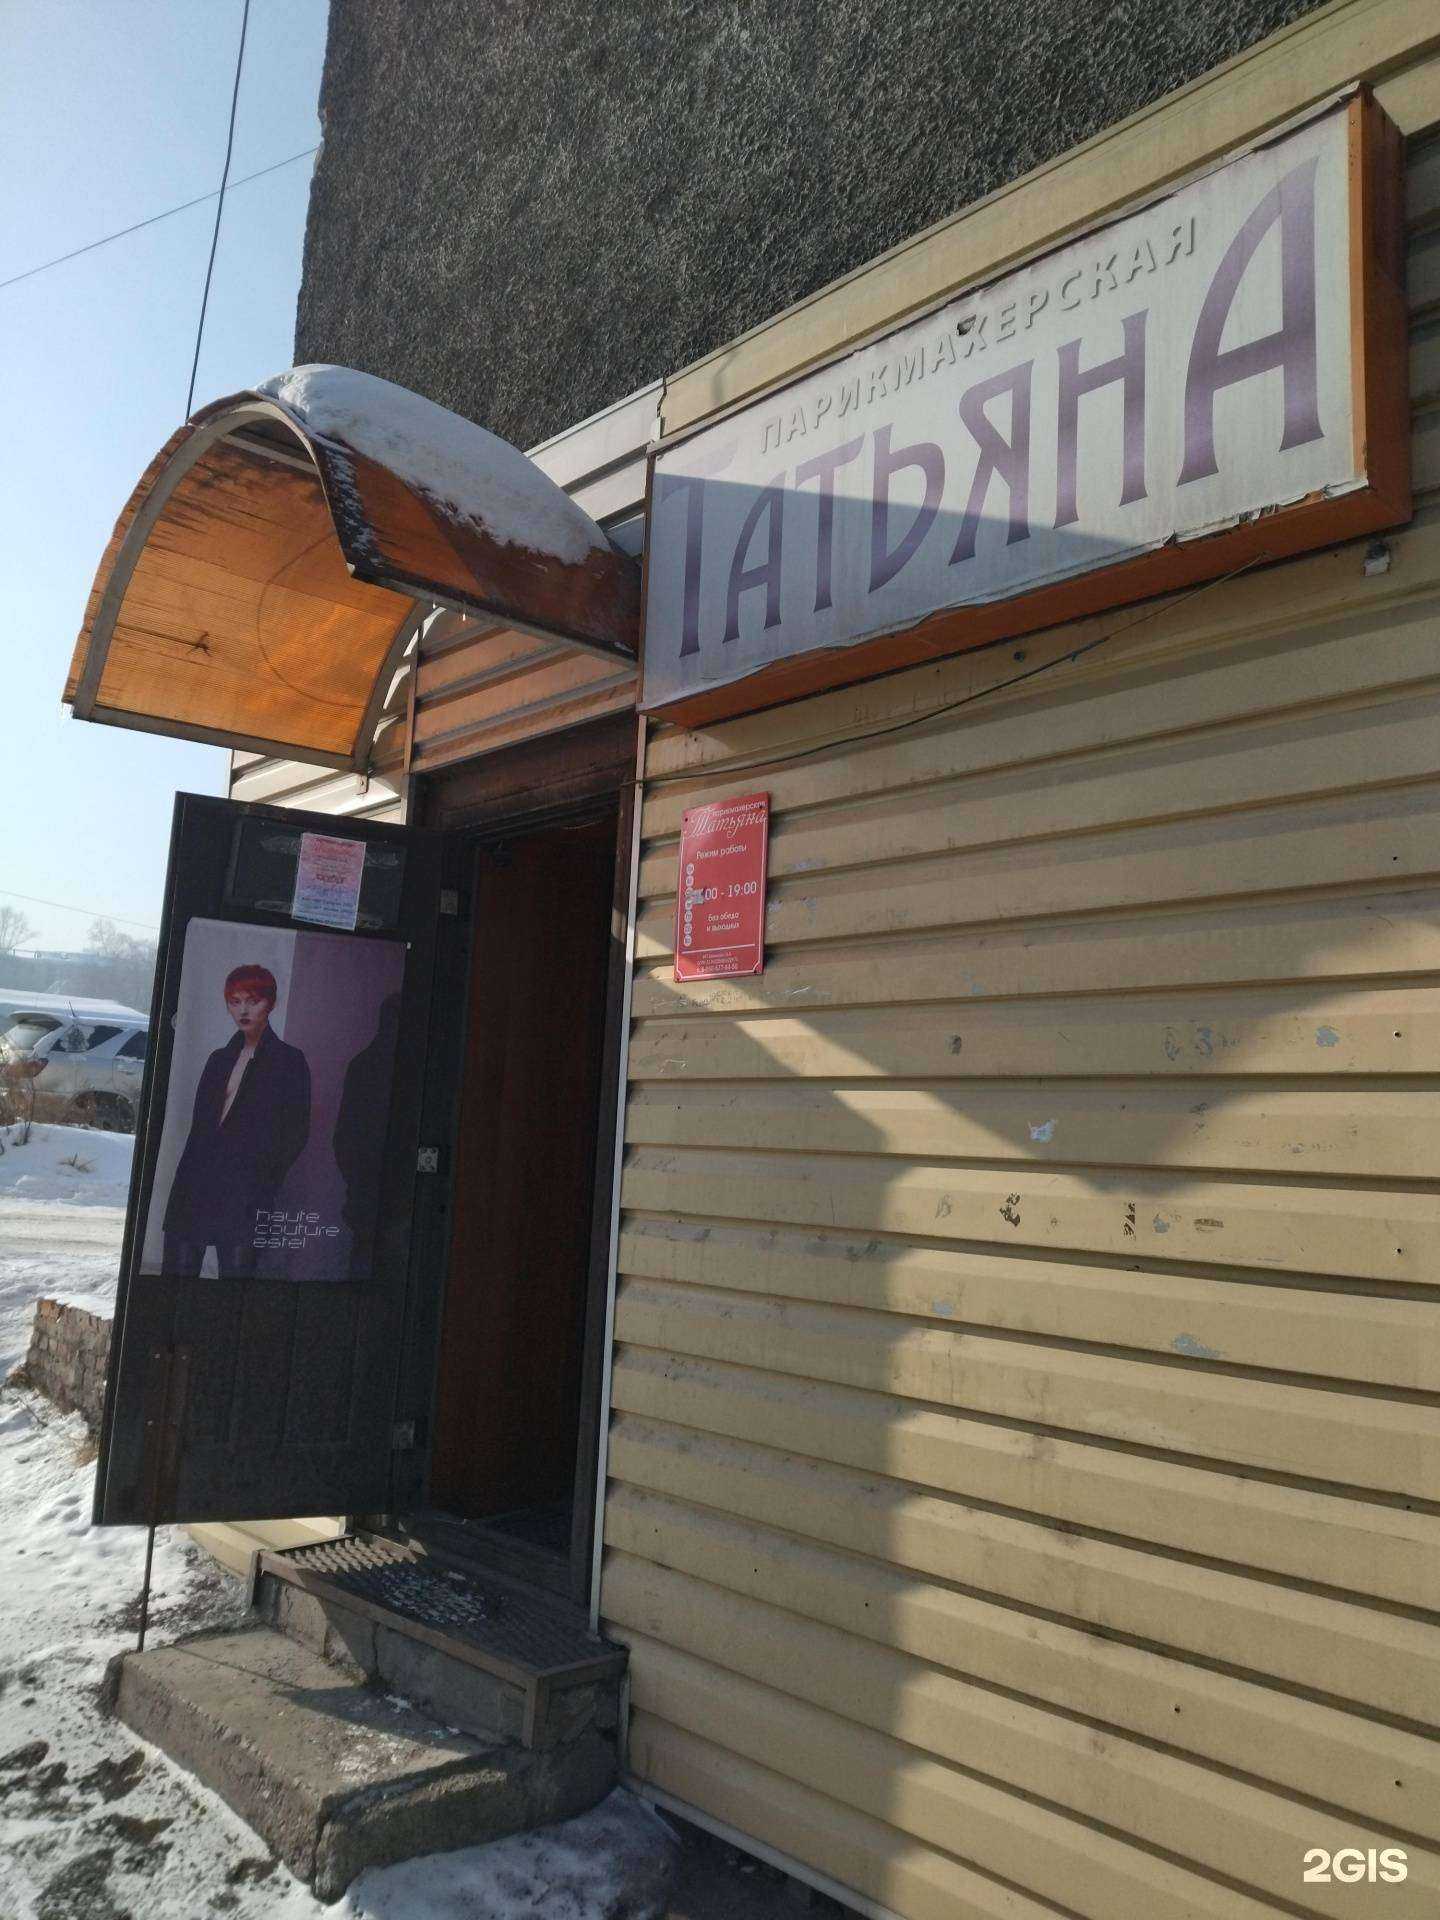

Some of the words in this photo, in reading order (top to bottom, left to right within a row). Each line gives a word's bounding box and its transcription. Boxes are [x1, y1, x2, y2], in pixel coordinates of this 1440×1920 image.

[760, 216, 1199, 454] ПАРИКМАХЕРСКАЯ
[696, 849, 719, 860] Режим
[720, 843, 748, 856] работы
[727, 881, 758, 898] 19:00
[255, 1208, 321, 1223] haute
[254, 1224, 341, 1237] couture
[252, 1236, 307, 1249] estel
